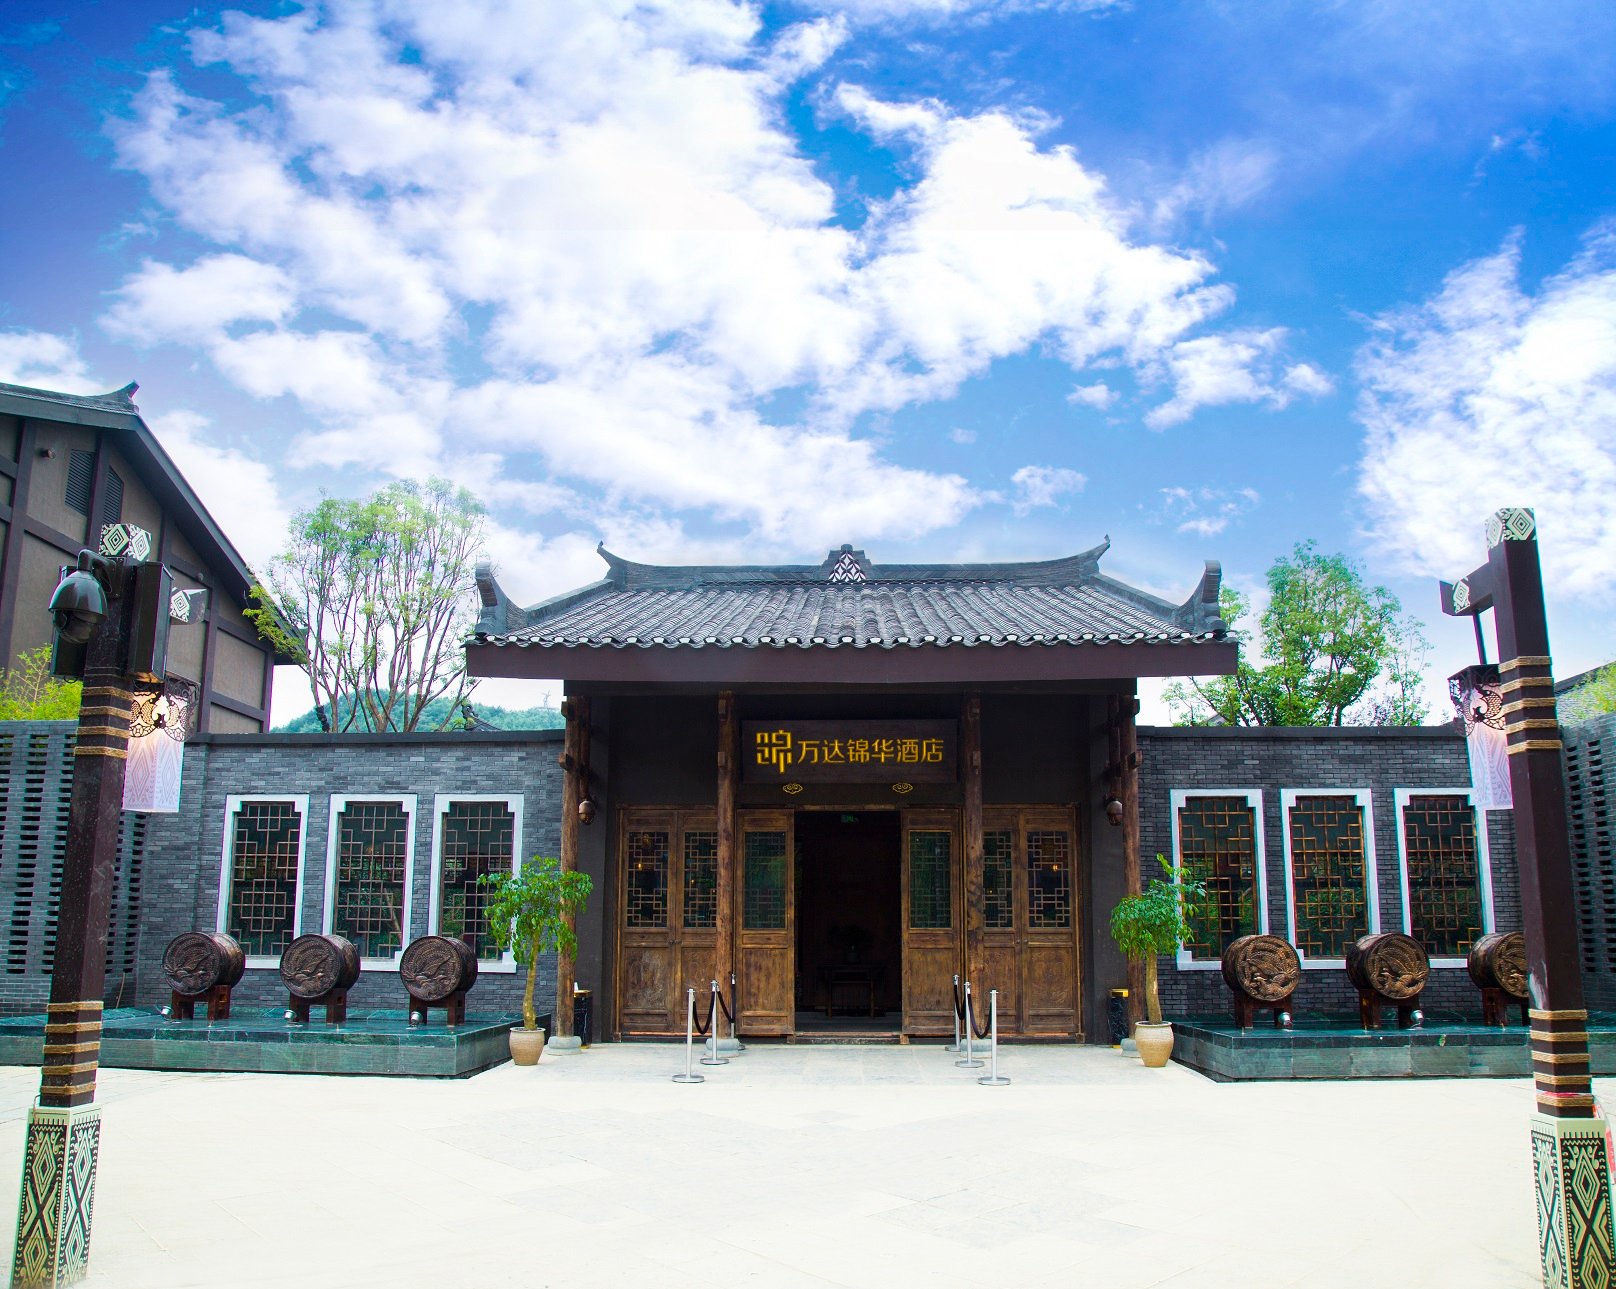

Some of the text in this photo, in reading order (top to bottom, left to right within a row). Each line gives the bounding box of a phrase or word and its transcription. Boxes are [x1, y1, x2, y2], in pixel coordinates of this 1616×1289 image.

[797, 738, 944, 764] 万达锦华酒店
